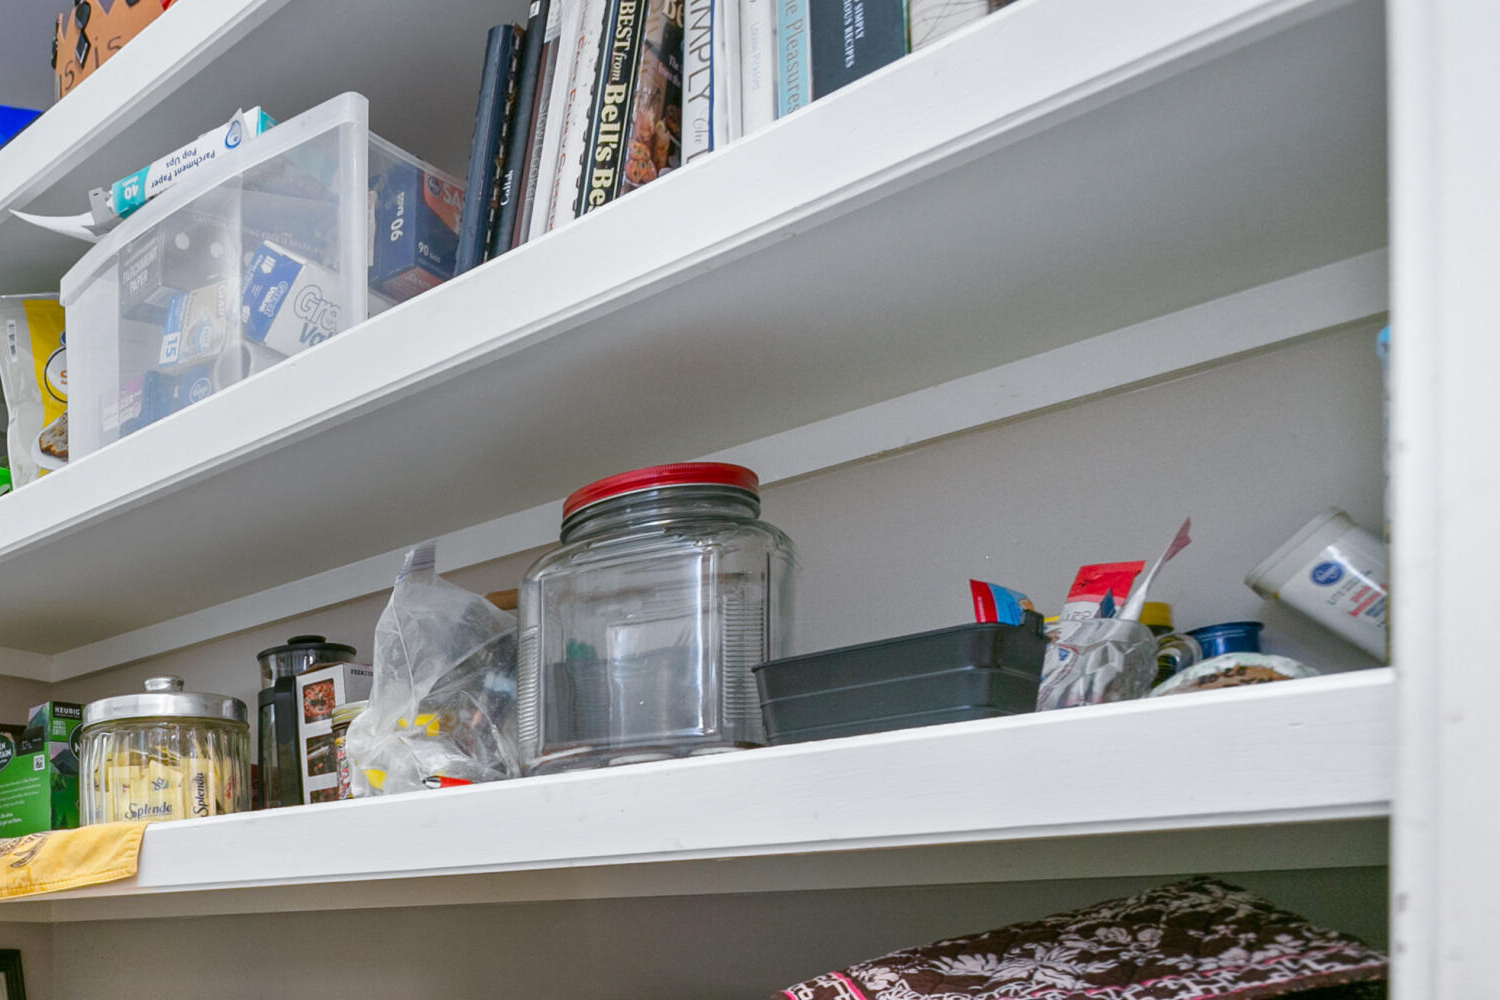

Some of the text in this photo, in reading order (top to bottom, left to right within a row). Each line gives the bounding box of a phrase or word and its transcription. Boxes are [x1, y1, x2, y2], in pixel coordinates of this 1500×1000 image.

[614, 0, 637, 52] BEST
[854, 2, 866, 40] SIMPLY
[844, 27, 856, 68] RECIPES
[611, 49, 627, 82] from
[785, 18, 805, 114] Pleasures
[595, 82, 628, 163] Bell's
[165, 148, 197, 169] Pop Ups
[173, 149, 216, 177] Parchment
[124, 184, 139, 200] 40
[151, 172, 173, 189] Paper
[390, 217, 405, 242] 90
[418, 242, 429, 256] 90
[293, 284, 341, 332] Gre
[164, 336, 179, 358] 15
[193, 772, 209, 818] Splenda
